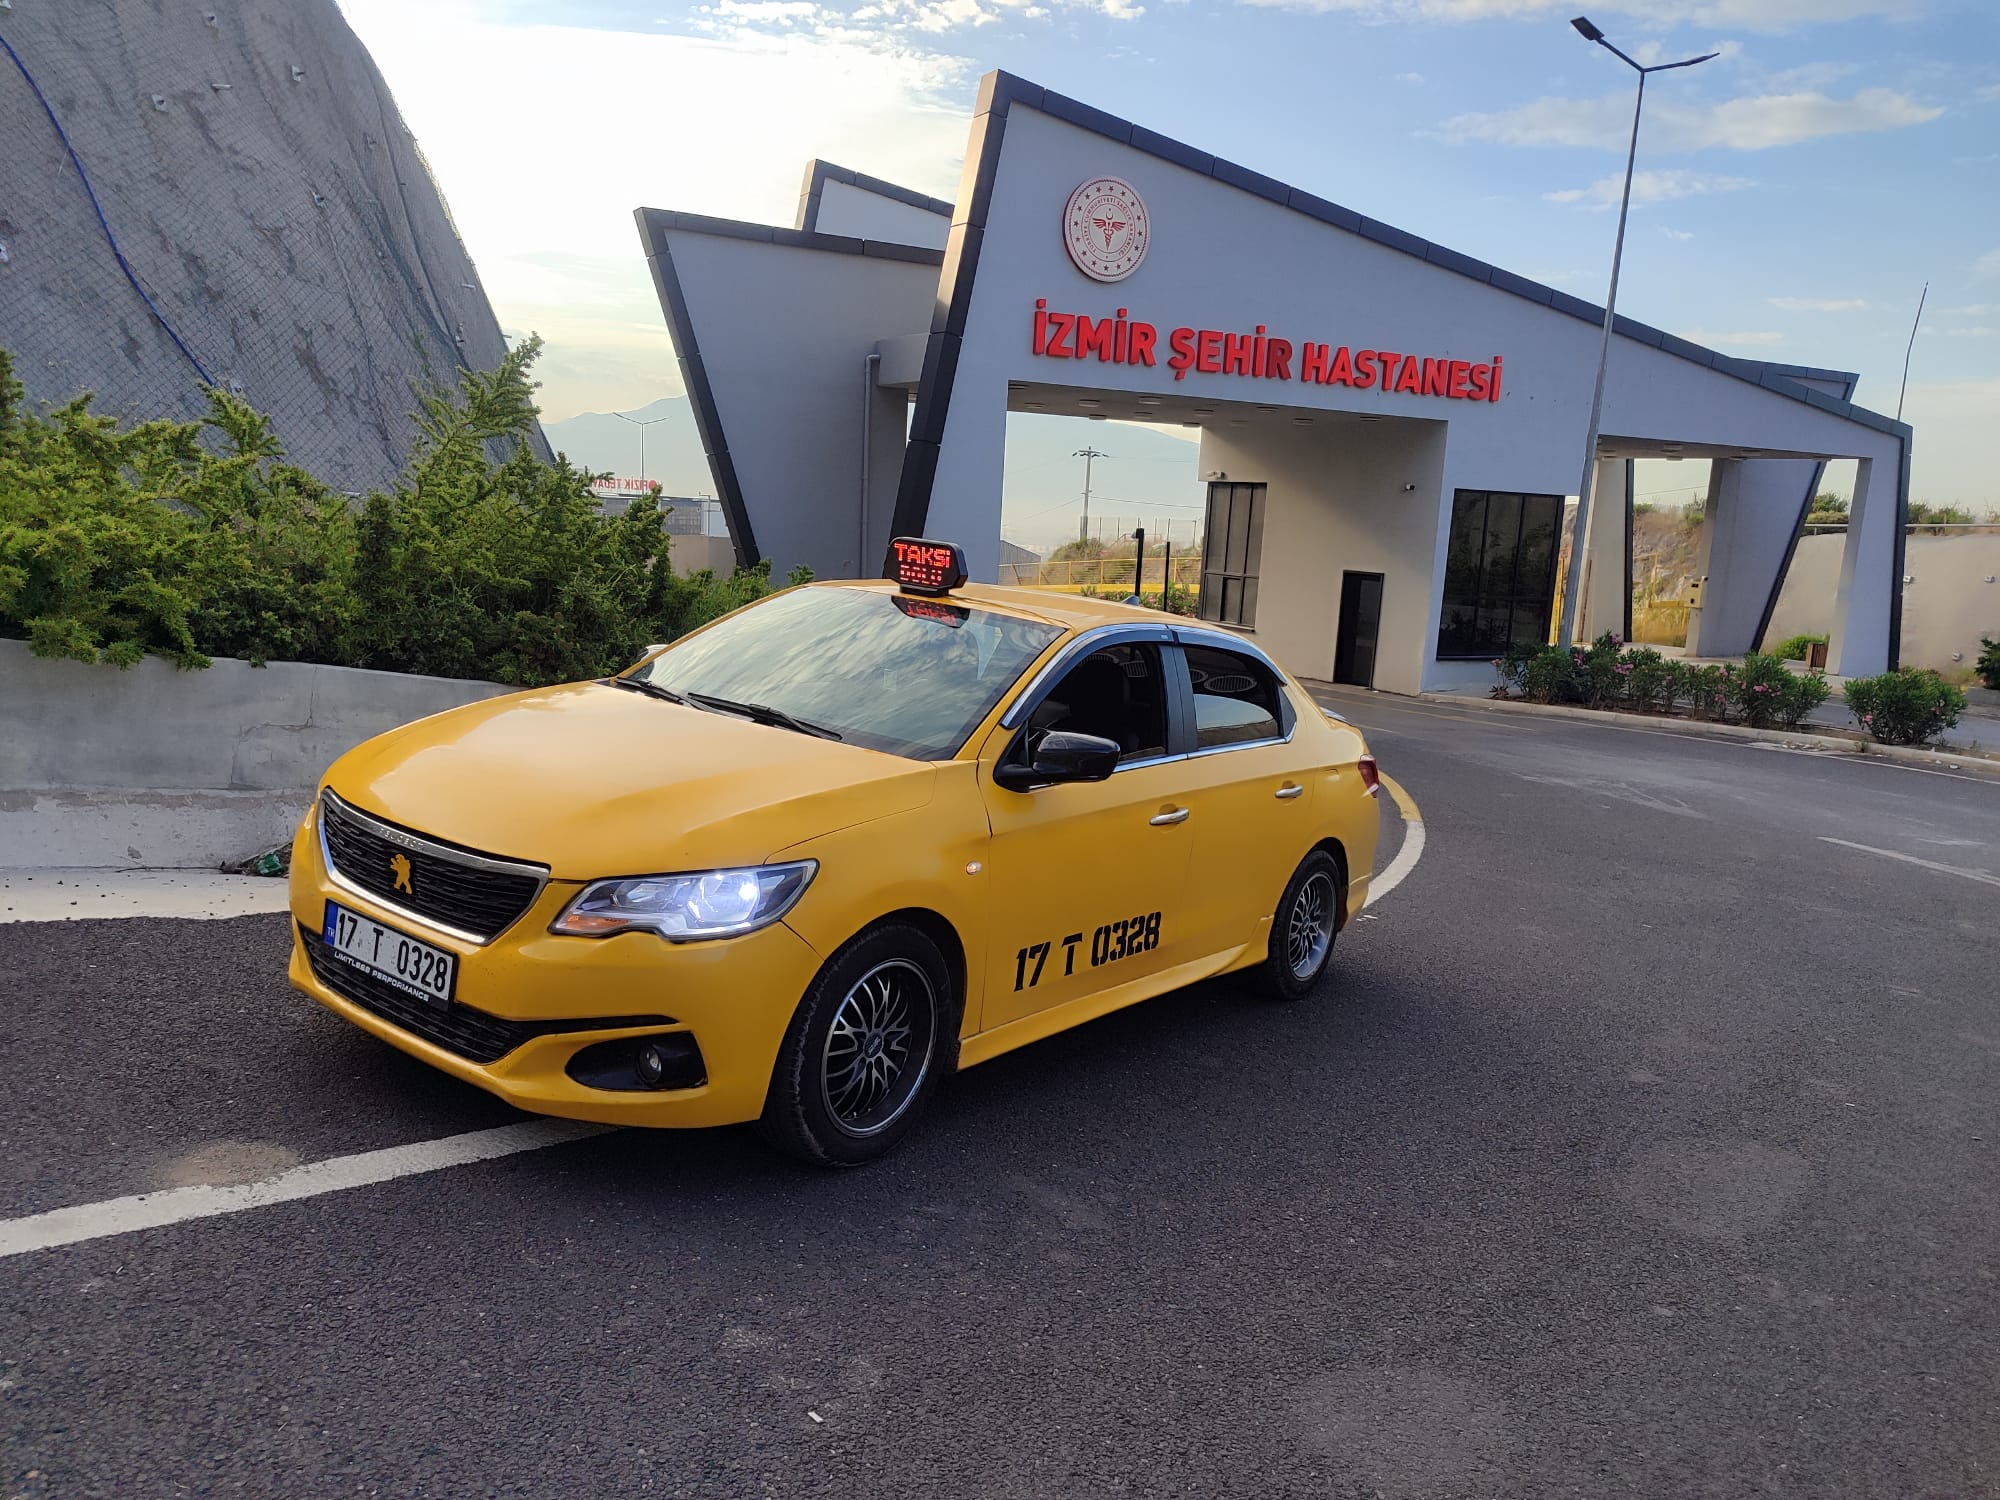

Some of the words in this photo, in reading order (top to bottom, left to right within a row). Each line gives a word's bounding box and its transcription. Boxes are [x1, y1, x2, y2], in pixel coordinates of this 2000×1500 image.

[1033, 298, 1157, 367] İZMİR
[1167, 325, 1293, 381] ŞEHİR
[1301, 342, 1503, 402] HASTANESİ
[334, 950, 371, 974] LIMITLESS
[372, 969, 430, 1002] PERFORMANCE
[338, 913, 358, 949] 17
[372, 927, 384, 962] T
[397, 940, 448, 993] 0328
[1013, 941, 1052, 992] 17
[1061, 932, 1083, 976] T
[1091, 911, 1162, 967] 0328
